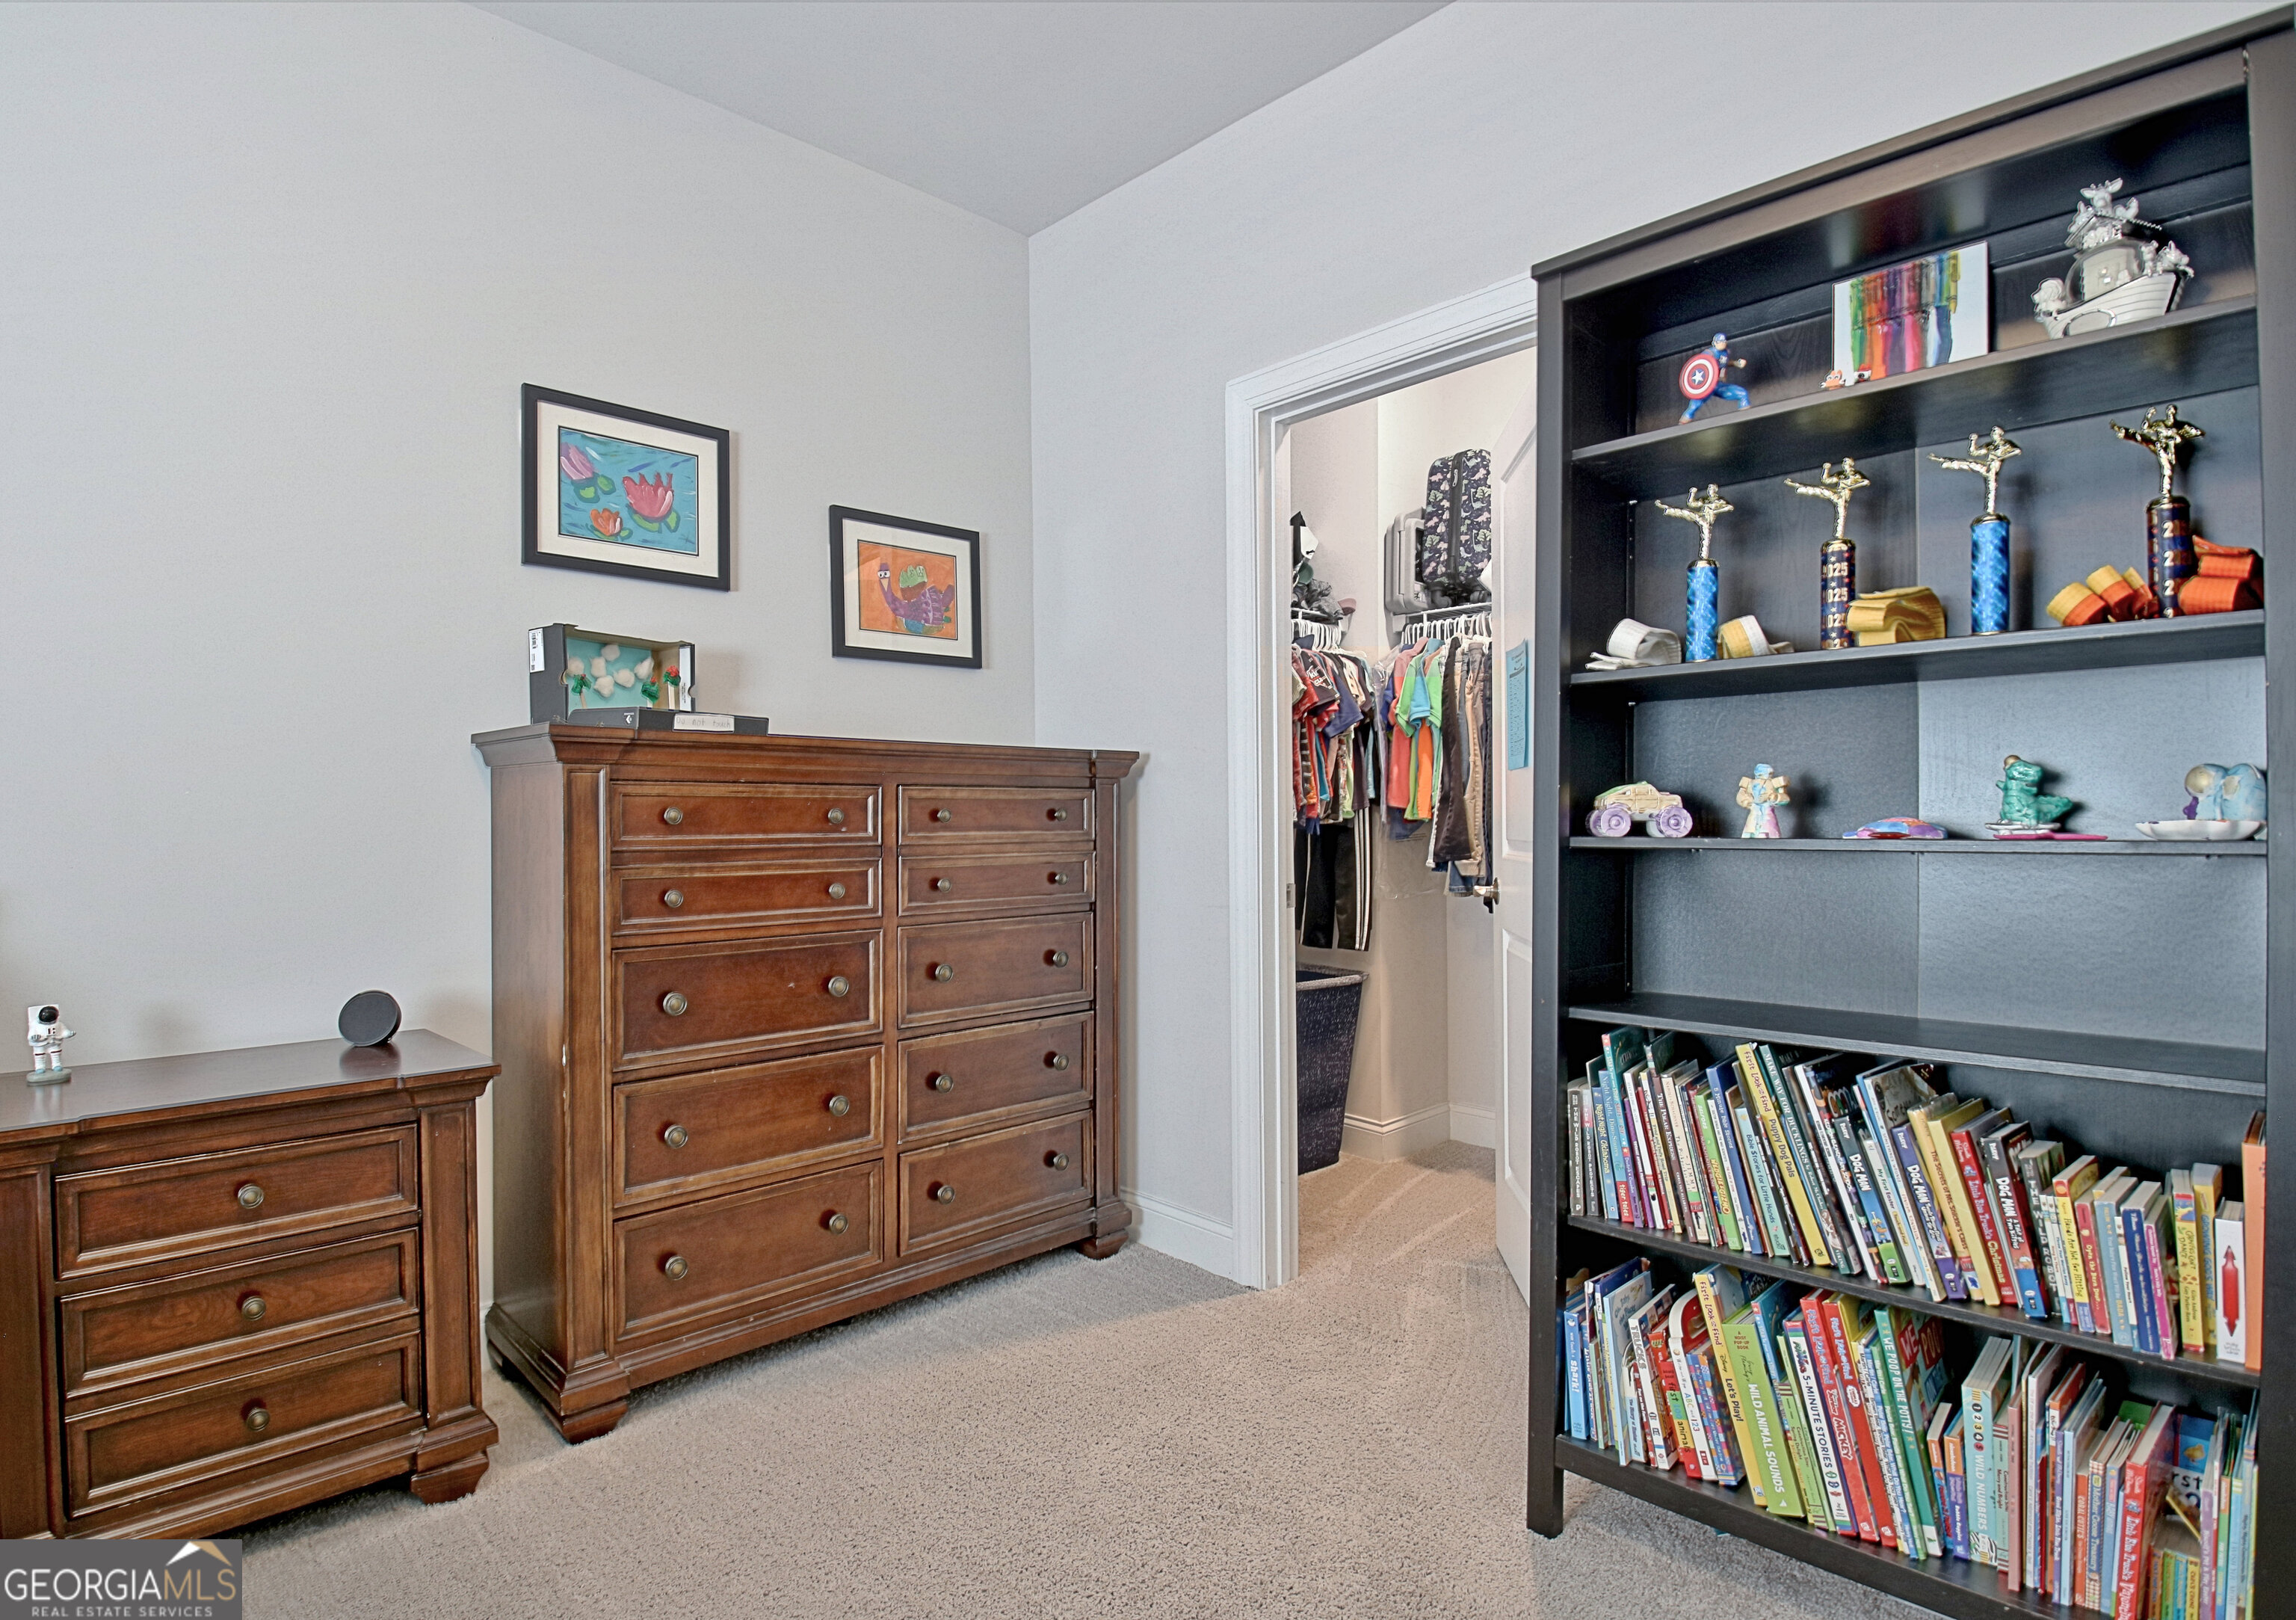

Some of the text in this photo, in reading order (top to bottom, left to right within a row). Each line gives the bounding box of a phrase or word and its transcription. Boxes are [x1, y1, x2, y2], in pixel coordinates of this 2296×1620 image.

[1763, 1052, 1776, 1072] MAKE
[1772, 1078, 1784, 1095] WAY
[1779, 1096, 1791, 1114] FOR
[1786, 1115, 1809, 1165] DUCKLINGS
[1595, 1103, 1611, 1173] Night Night Oklahoma
[1745, 1133, 1755, 1149] Bible
[1767, 1118, 1796, 1178] Puppy Dog Pals
[1930, 1150, 1939, 1163] The
[1750, 1150, 1762, 1174] Stories
[1757, 1174, 1765, 1183] for
[1848, 1153, 1871, 1192] DOG MAN
[1906, 1164, 1922, 1184] DOG
[1934, 1162, 1947, 1187] Secrets
[1617, 1183, 1627, 1200] tiger
[1710, 1158, 1723, 1184] WEDGIE
[1718, 1189, 1730, 1215] GIZMO
[1760, 1185, 1771, 1203] Little
[1876, 1168, 1895, 1210] My First Easter
[1913, 1183, 1930, 1204] MAN
[1996, 1176, 2017, 1218] DOG MAN
[1621, 1201, 1629, 1216] tales
[1765, 1203, 1776, 1223] Hands
[1957, 1232, 1968, 1250] Class
[1967, 1178, 2008, 1283] Little Blue Truck's Christmas
[2028, 1180, 2057, 1292] THE WILD ROBOT
[1834, 1249, 1845, 1269] VIKING
[2063, 1217, 2084, 1298] Hands Are Not for Hitting
[2084, 1244, 2093, 1259] Open
[1629, 1325, 1647, 1370] TRUCKS
[1901, 1323, 1918, 1361] WE
[1570, 1359, 1579, 1393] shark!
[1883, 1337, 1913, 1435] WE POOP ON THE POTTY!
[1667, 1382, 1679, 1402] first
[1676, 1420, 1691, 1453] animals
[1684, 1392, 1700, 1432] ABC 123
[1724, 1377, 1744, 1423] Let's Play!
[1802, 1373, 1821, 1423] 5-MINUTE
[1815, 1425, 1832, 1468] STORIES
[1747, 1382, 1785, 1494] WILD ANIMAL SOUNDS
[1832, 1415, 1854, 1461] MICKEY
[1975, 1454, 1984, 1478] WILD
[1975, 1482, 1987, 1530] NUMBERS
[2089, 1487, 2101, 1570] Mother Goose Treasury
[2121, 1516, 2139, 1580] Little Blue Truck's
